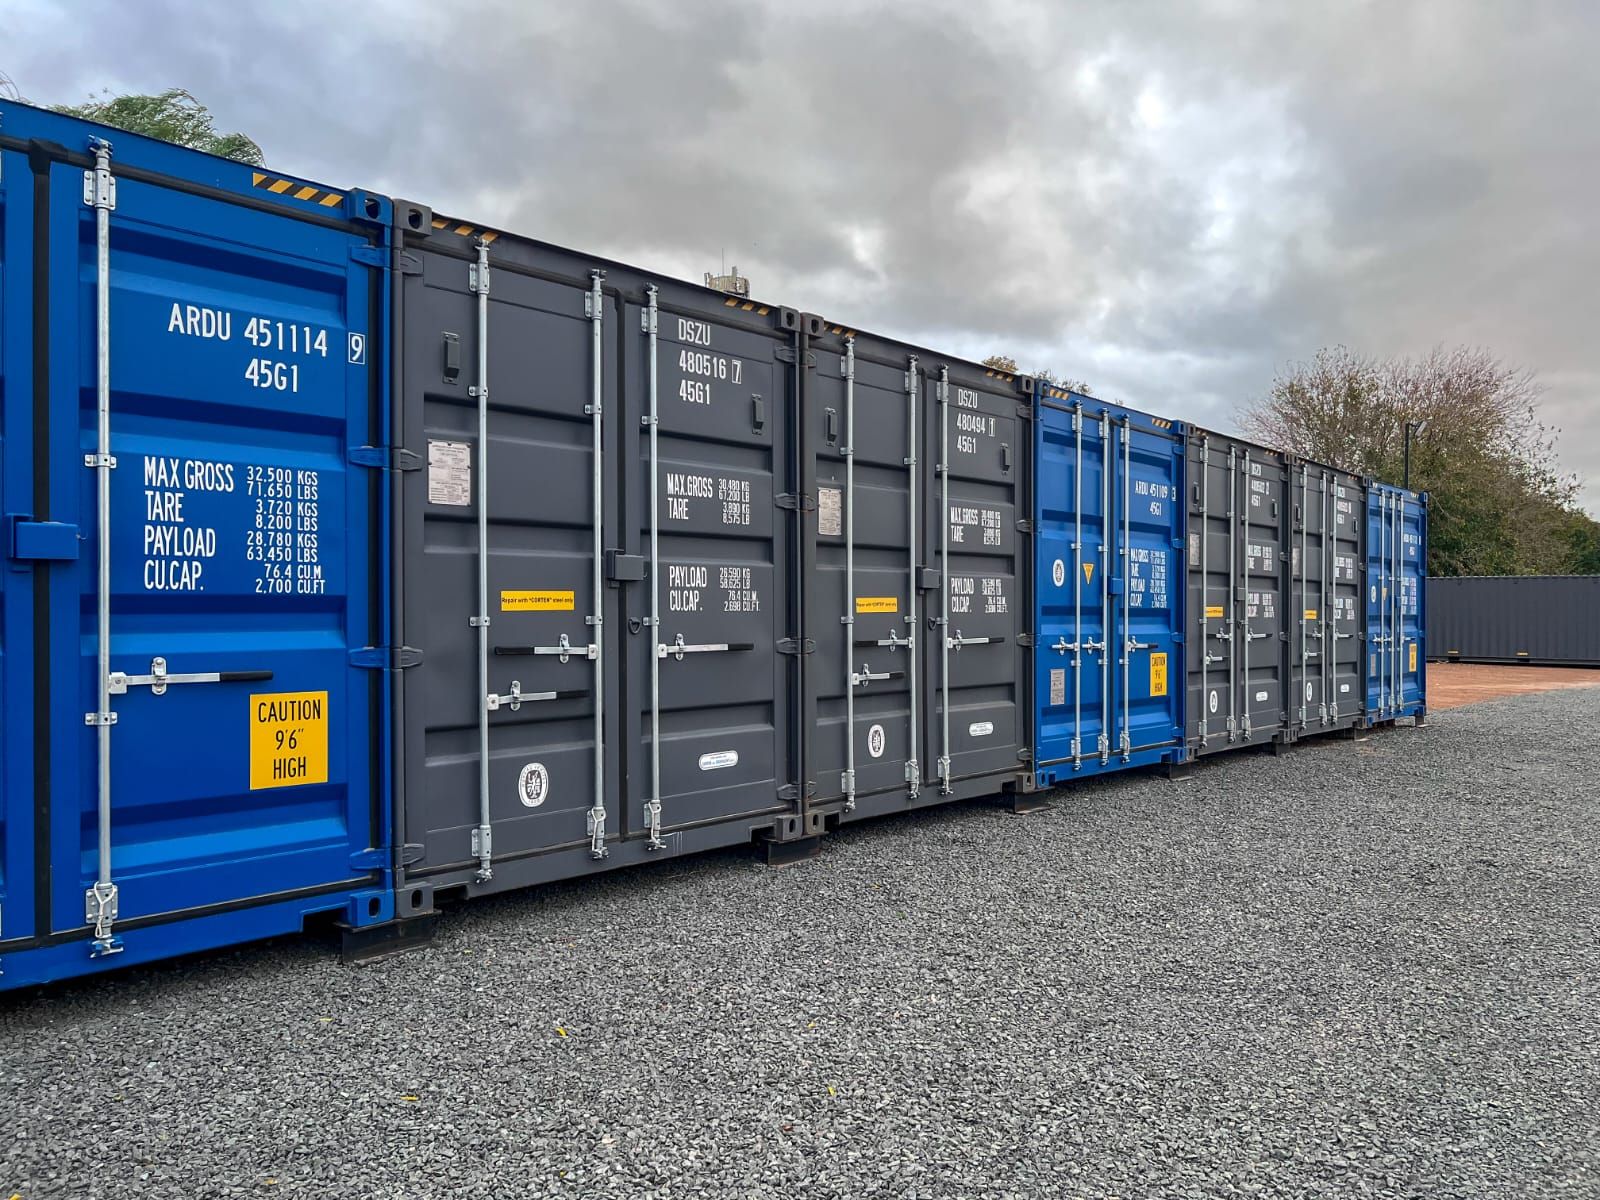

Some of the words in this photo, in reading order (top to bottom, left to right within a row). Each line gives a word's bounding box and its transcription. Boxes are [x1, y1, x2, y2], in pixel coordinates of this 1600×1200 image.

[168, 303, 231, 341] ARDU
[243, 317, 328, 358] 451114
[349, 334, 364, 363] 9
[678, 318, 711, 346] DSZU
[244, 358, 298, 393] 45G1
[679, 349, 727, 380] 480516
[732, 360, 741, 384] 7
[679, 379, 711, 405] 45G1
[958, 388, 978, 409] DSZU
[956, 412, 986, 434] 480494
[956, 435, 976, 454] 45G1
[144, 455, 181, 488] MAX
[184, 459, 235, 493] GROSS
[297, 470, 318, 486] KGS
[297, 485, 318, 501] LBS
[741, 480, 750, 492] KG
[144, 490, 185, 523] TARE
[741, 491, 750, 503] LB
[297, 501, 318, 517] KGS
[667, 497, 689, 520] TARE
[741, 503, 750, 514] KG
[297, 517, 318, 532] LBS
[741, 513, 750, 525] LB
[144, 524, 216, 558] PAYLOAD
[297, 533, 318, 548] KGS
[297, 548, 318, 563] LBS
[143, 559, 204, 592] CU.CAP.
[264, 563, 292, 579] 76.4
[297, 564, 322, 580] CU.M
[668, 565, 708, 588] PAYLOAD
[742, 567, 751, 579] KG
[297, 579, 326, 595] CU.FT
[742, 578, 751, 590] LB
[258, 698, 321, 723] CAUTION
[273, 755, 307, 780] HIGH
